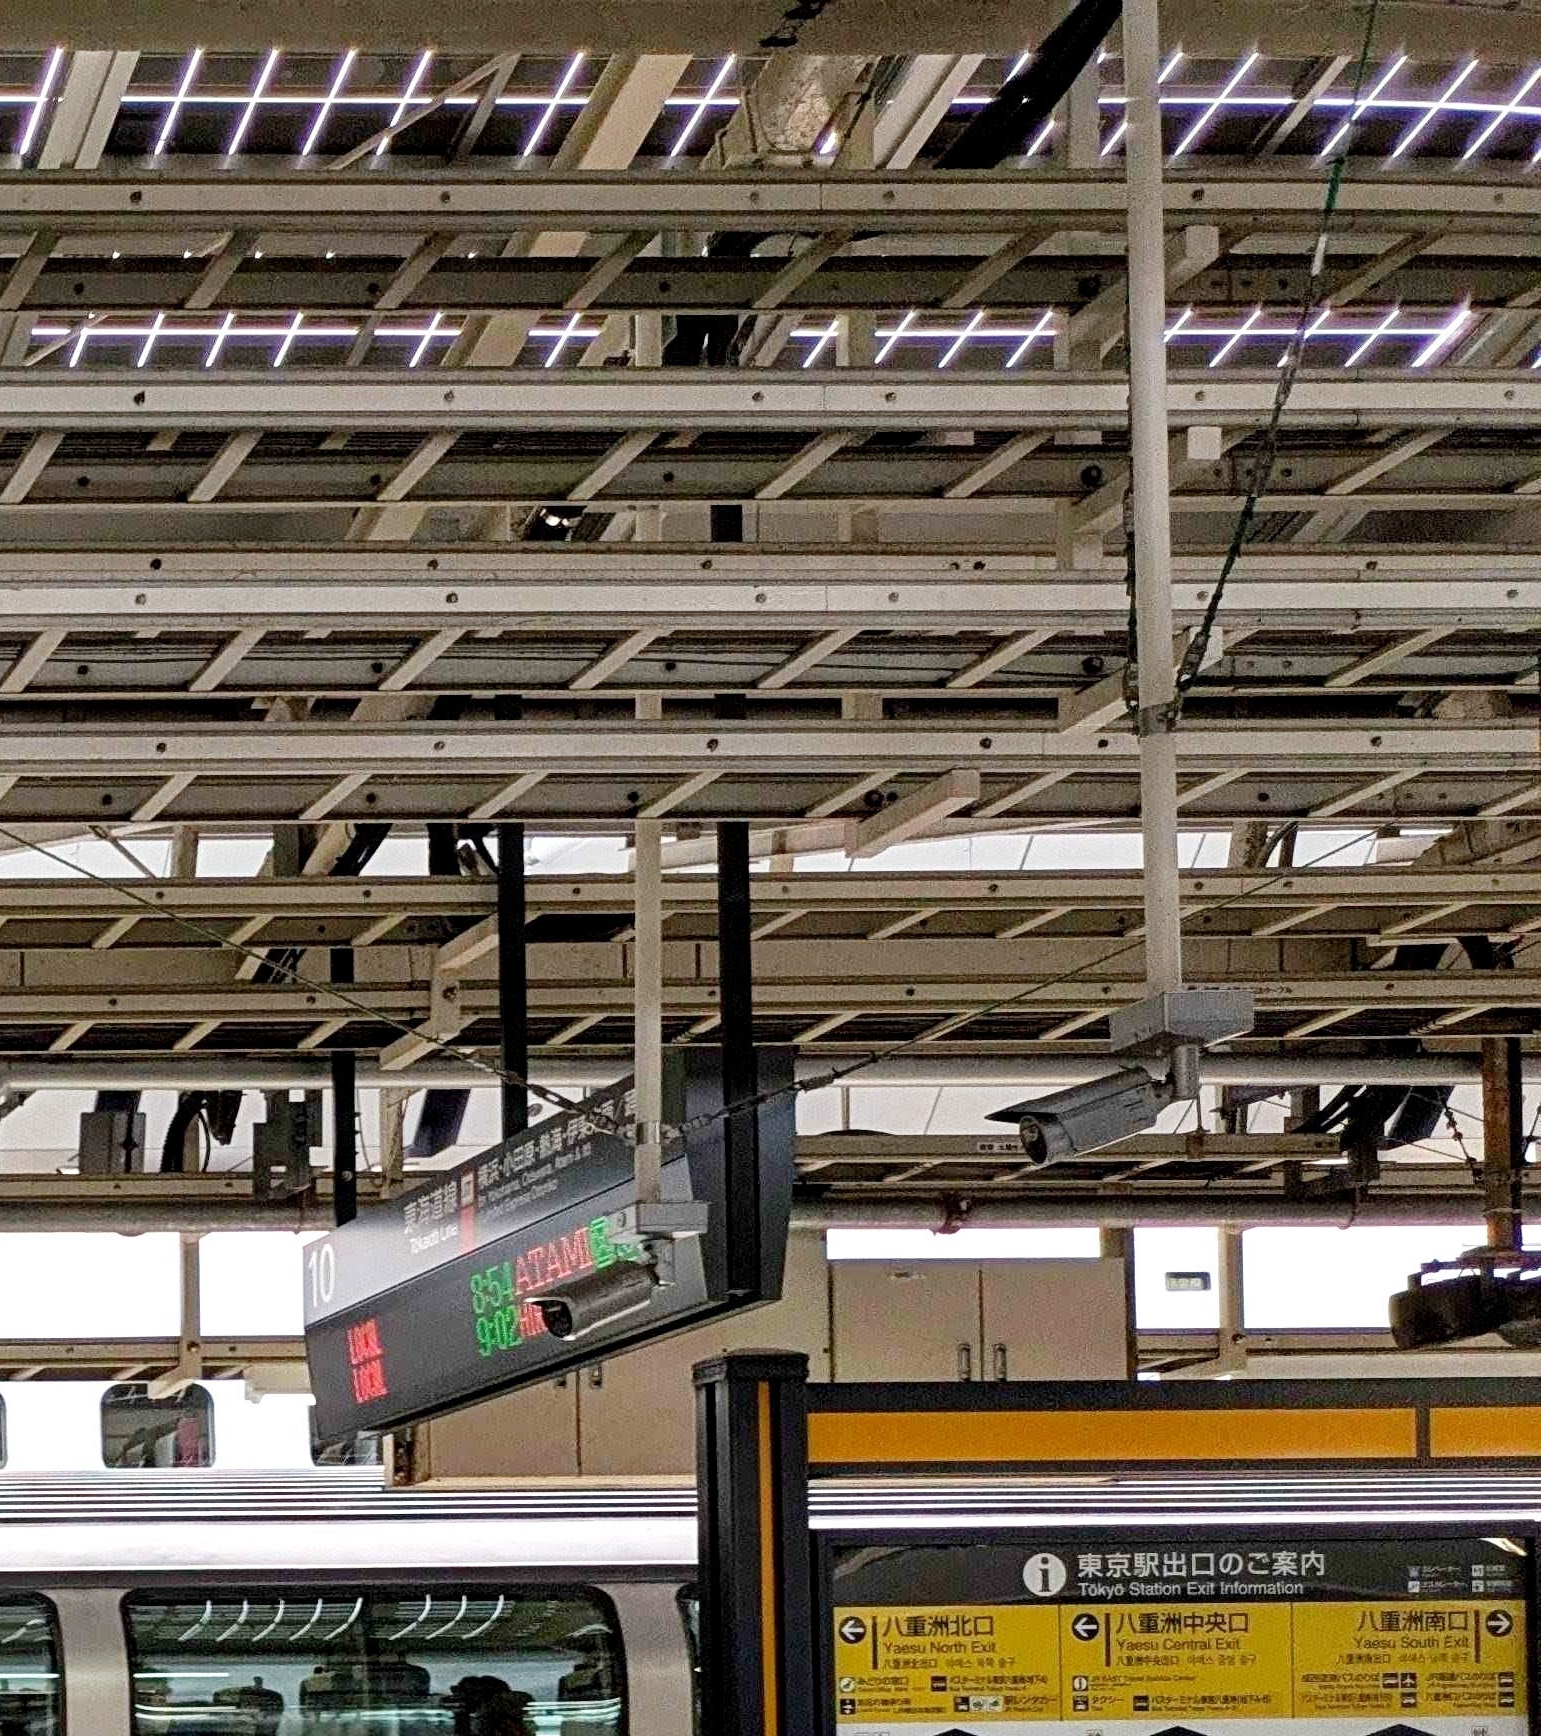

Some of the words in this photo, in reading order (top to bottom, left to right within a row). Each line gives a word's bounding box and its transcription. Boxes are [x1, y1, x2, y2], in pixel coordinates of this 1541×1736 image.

[309, 1243, 335, 1307] 10
[471, 1262, 514, 1314] 8:54
[515, 1227, 593, 1295] ATAMI
[1077, 1550, 1325, 1578] 東京駅出口のご案内
[1078, 1582, 1124, 1599] Tōkyō
[1129, 1582, 1181, 1596] Station
[1187, 1582, 1215, 1594] Exit
[1220, 1581, 1303, 1595] Information
[883, 1615, 993, 1637] 八重洲北口
[1117, 1612, 1249, 1634] 八重洲中央口
[1357, 1610, 1467, 1632] 八重洲南口
[883, 1642, 925, 1654] Yaesu
[930, 1642, 966, 1653] North
[972, 1642, 996, 1652] Exit
[1117, 1640, 1158, 1650] Yaesu
[1163, 1639, 1211, 1650] Central
[1216, 1639, 1240, 1649] Exit
[1354, 1637, 1396, 1649] Yaesu
[1401, 1637, 1439, 1649] South
[1444, 1636, 1469, 1648] Exit
